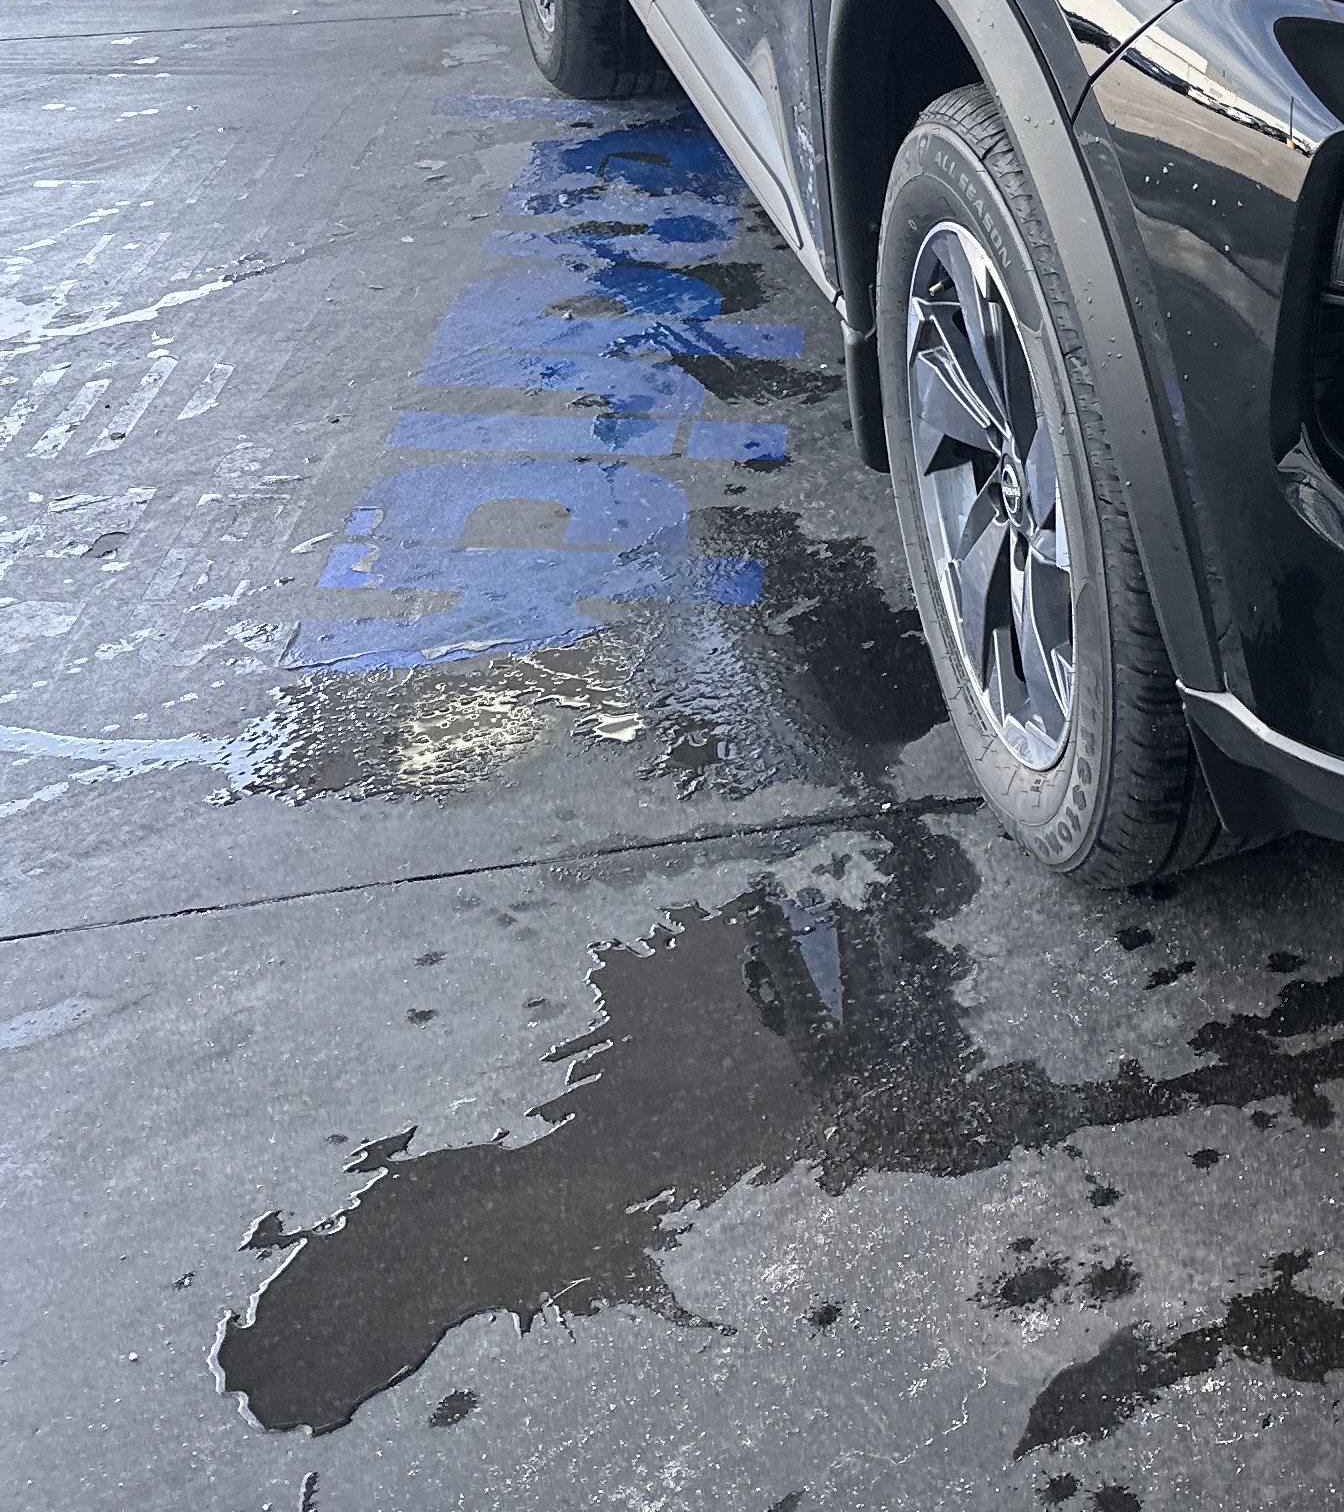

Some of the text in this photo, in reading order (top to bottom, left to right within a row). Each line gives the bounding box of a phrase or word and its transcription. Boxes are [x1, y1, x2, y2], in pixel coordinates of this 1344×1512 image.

[274, 94, 806, 671] endrick
[933, 150, 1012, 269] ALL SEASON
